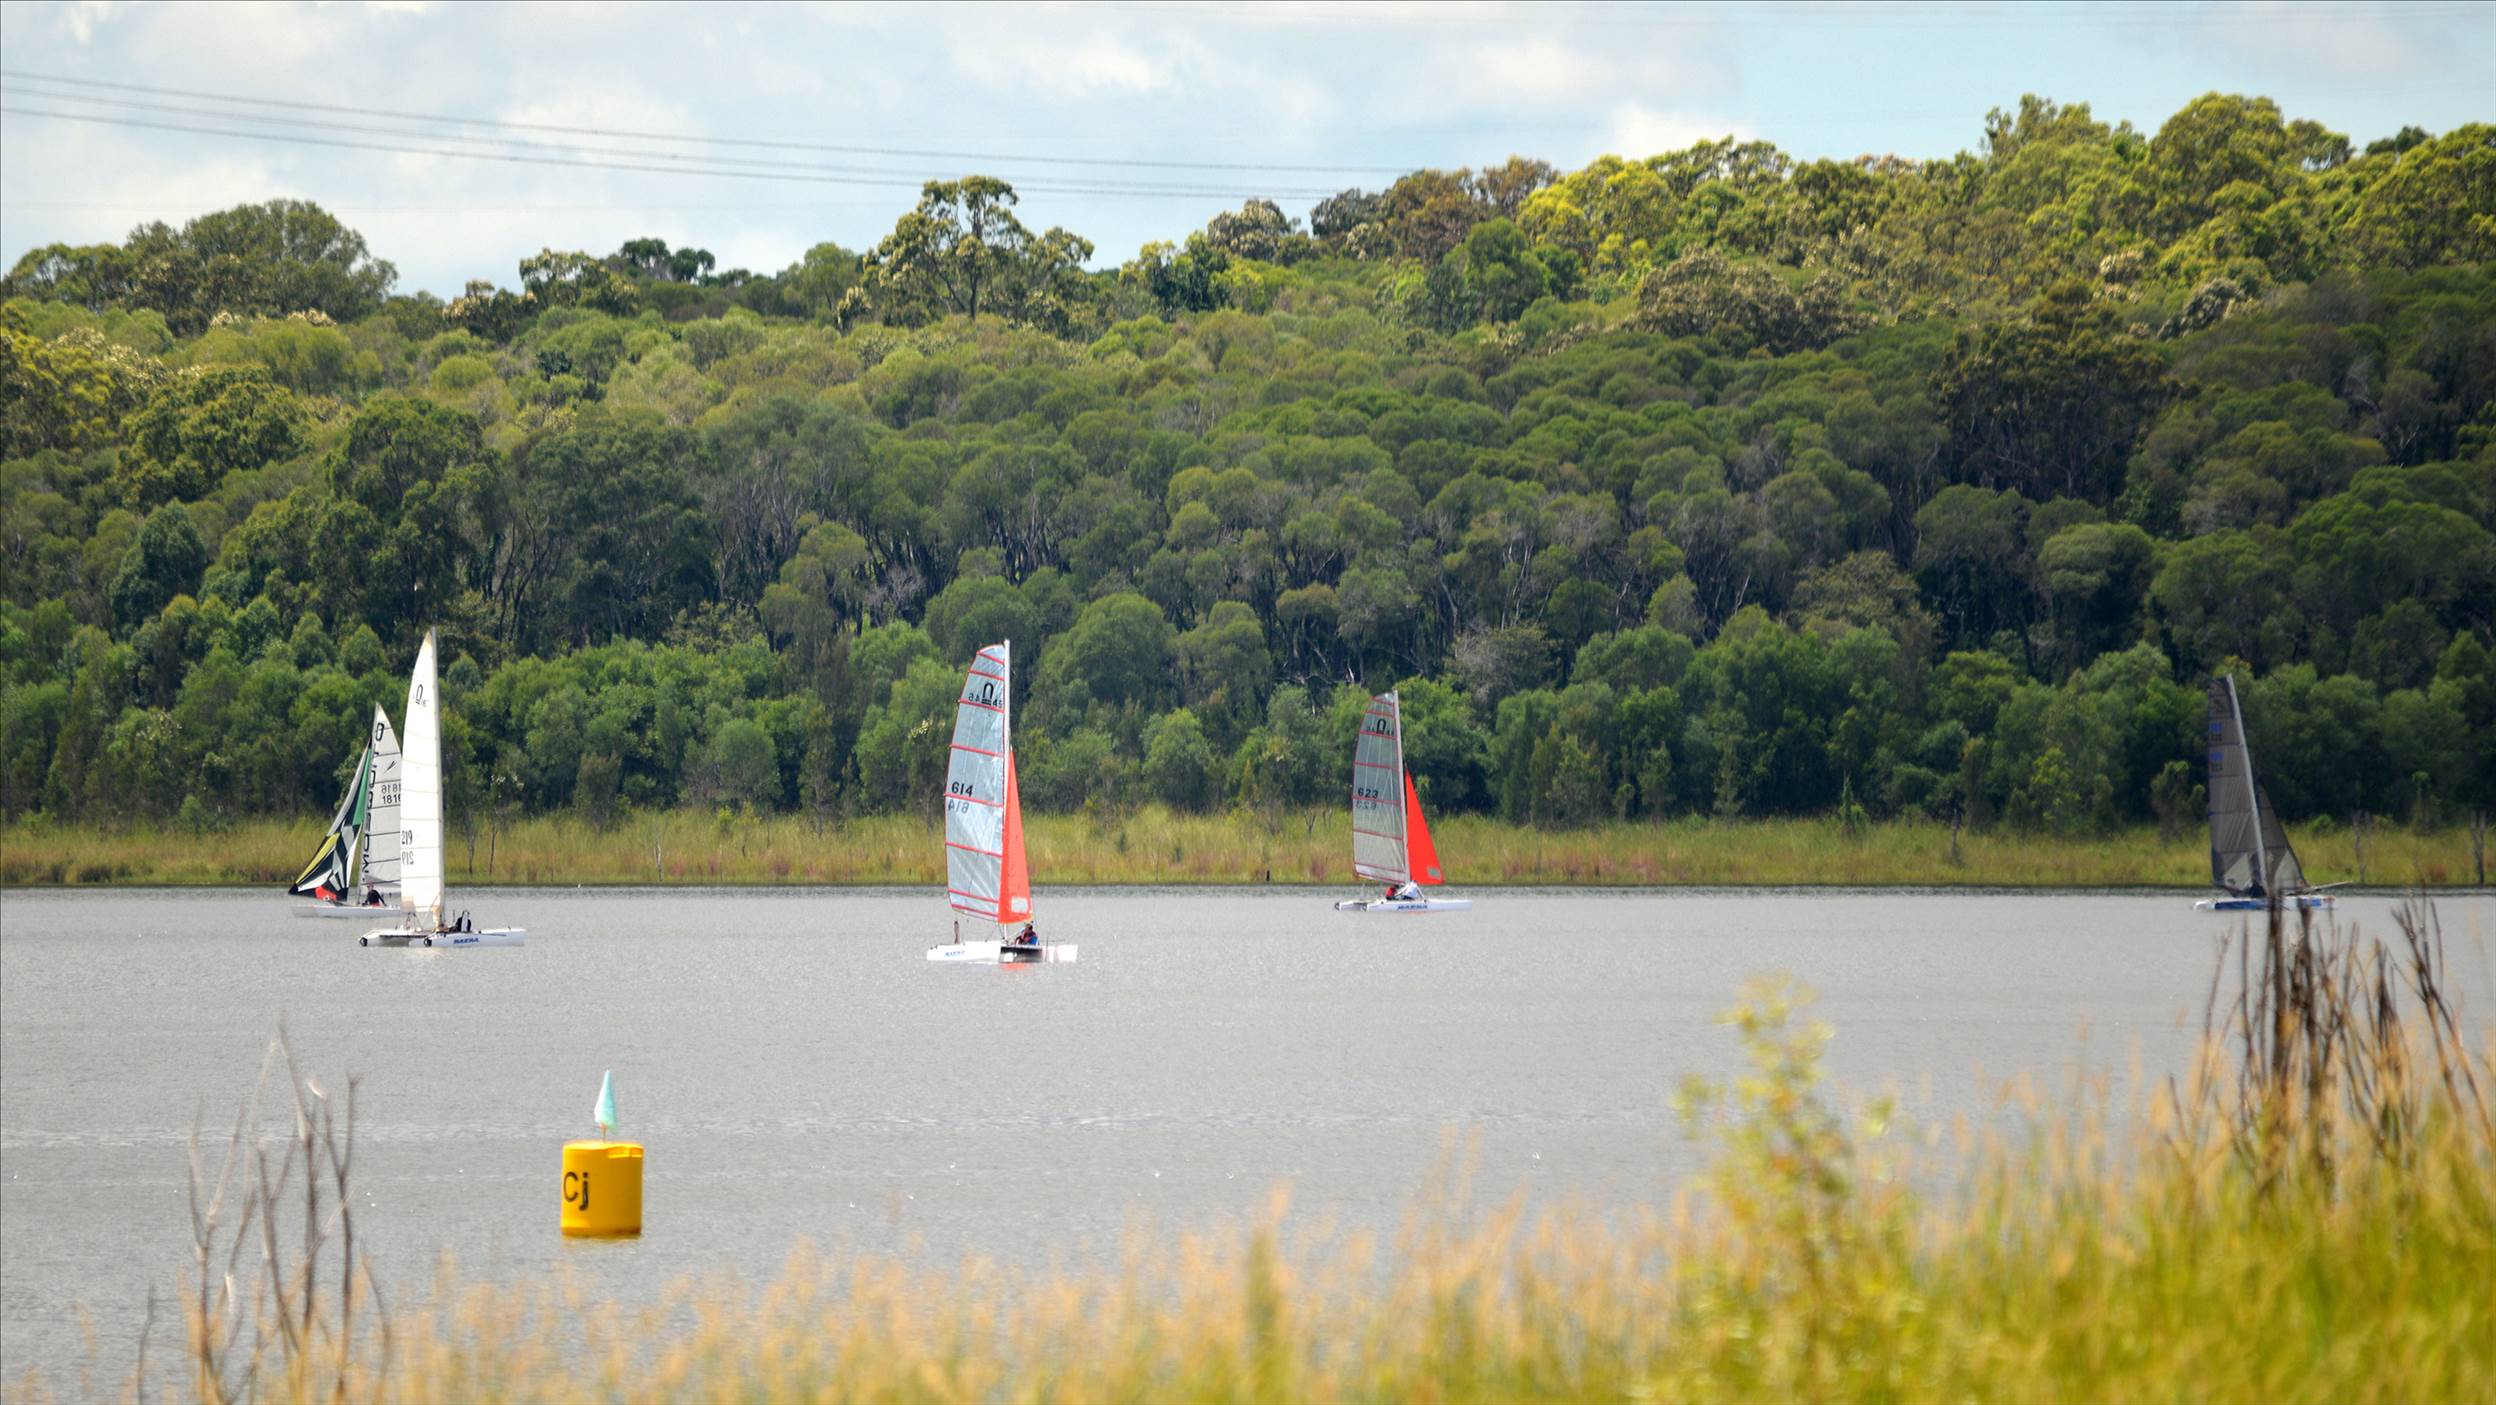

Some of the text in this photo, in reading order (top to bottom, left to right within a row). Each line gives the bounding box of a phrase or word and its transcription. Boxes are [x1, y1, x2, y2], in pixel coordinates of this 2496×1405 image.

[951, 781, 974, 797] 614
[1357, 787, 1379, 799] 623
[563, 1171, 590, 1212] Cj
